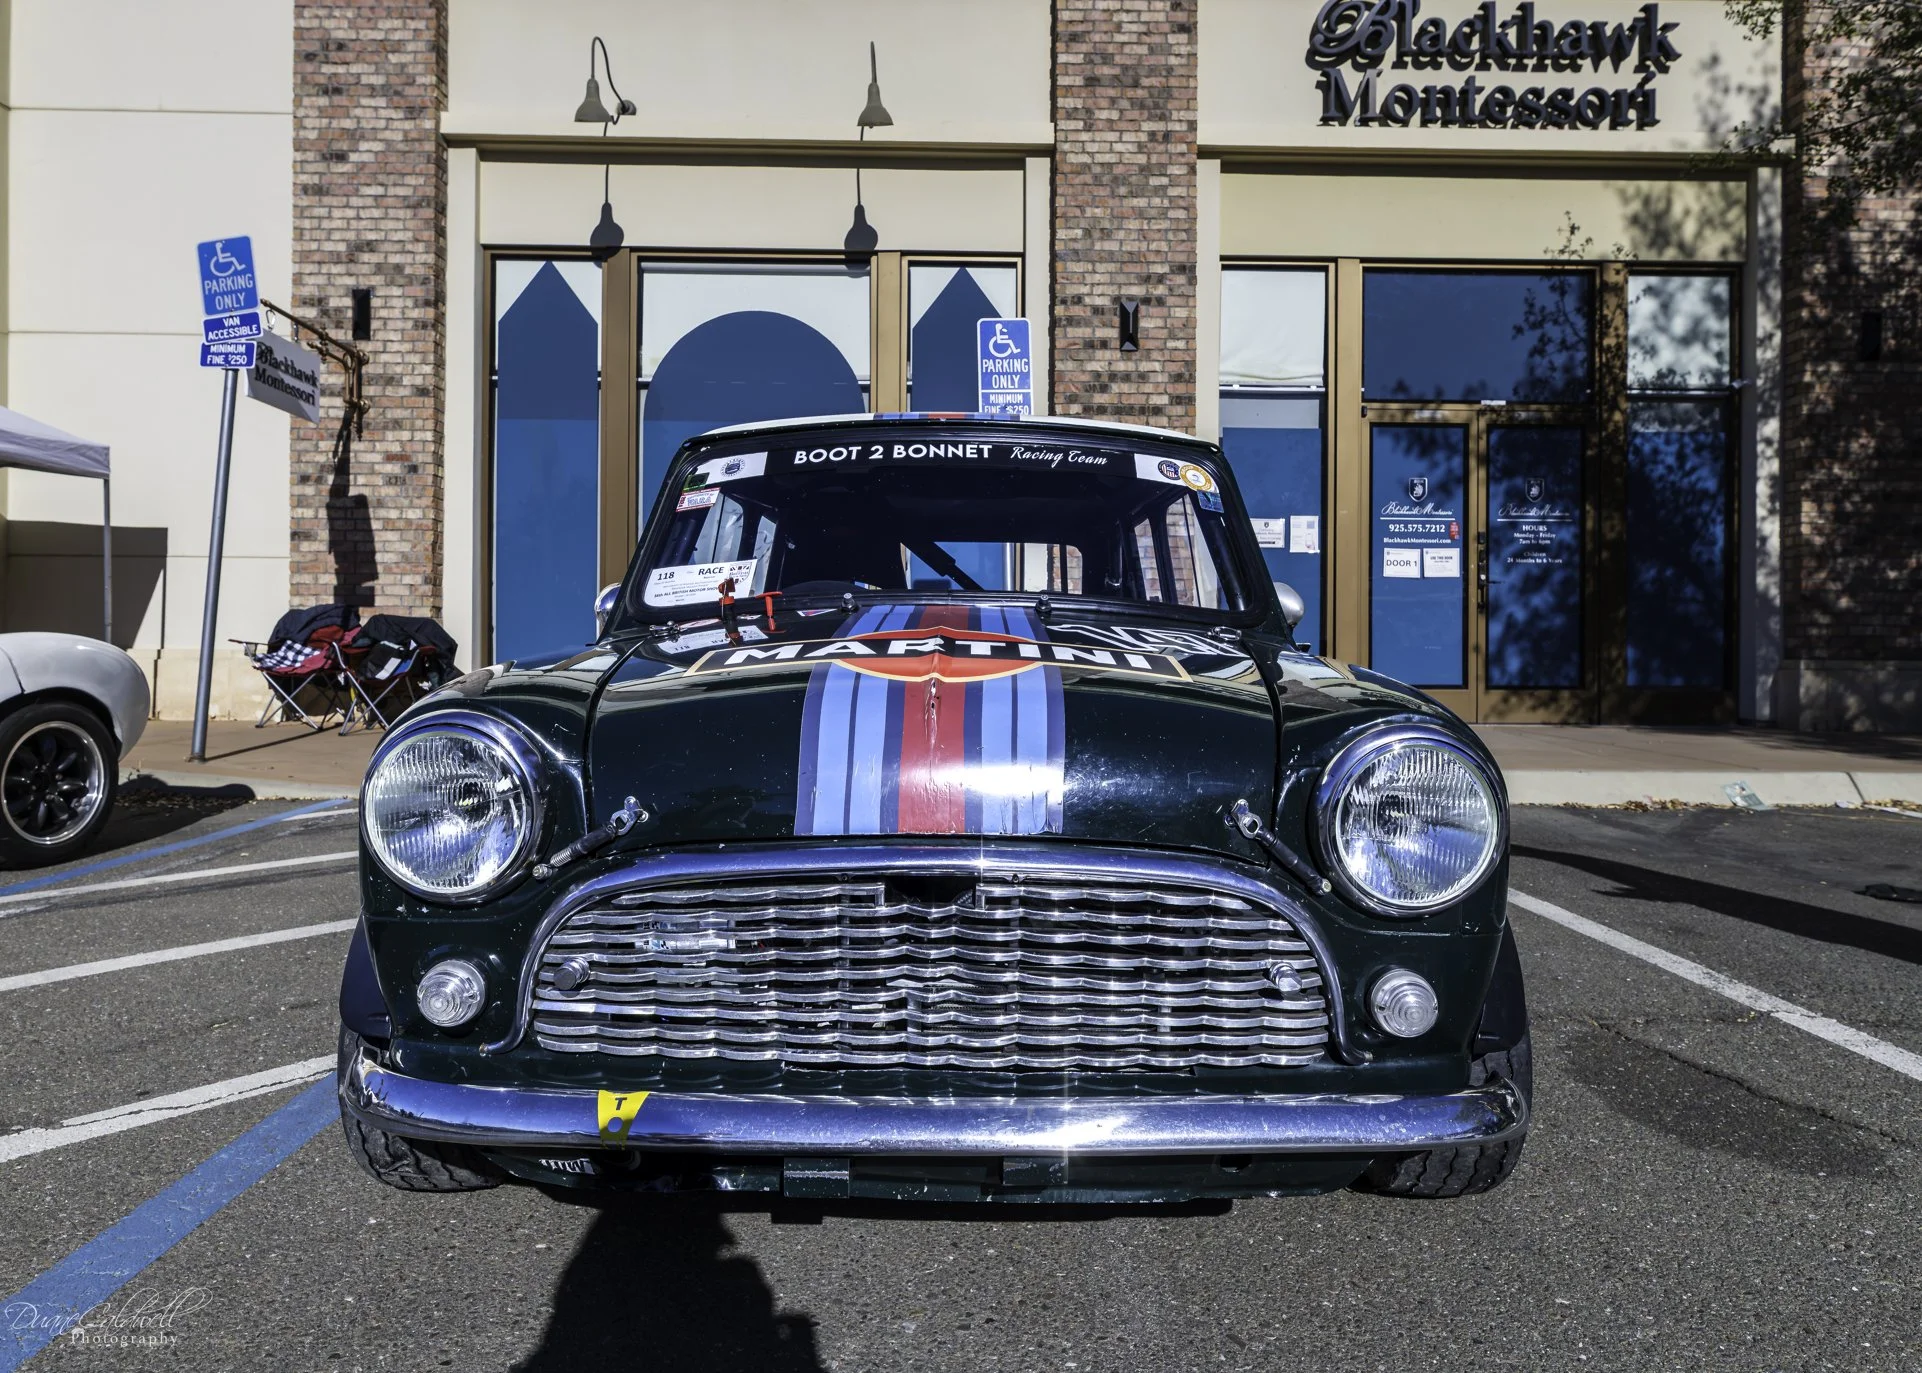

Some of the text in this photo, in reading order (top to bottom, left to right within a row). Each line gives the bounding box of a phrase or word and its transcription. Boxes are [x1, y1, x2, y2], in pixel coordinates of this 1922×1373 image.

[1309, 0, 1682, 64] Blackhawk
[1319, 68, 1661, 126] Montessori
[204, 273, 254, 295] PARKING
[215, 292, 246, 311] ONLY
[222, 316, 241, 327] VAN
[207, 325, 259, 341] ACCESSIBLE
[209, 344, 246, 354] MINIMUM
[206, 354, 248, 365] FINE $250
[256, 341, 319, 388] Blackhawk
[982, 358, 1029, 373] PARKING
[254, 364, 316, 406] Montessori
[991, 374, 1020, 389] ONLY
[989, 393, 1024, 404] MINIMUM
[984, 405, 1029, 415] FINE $250
[793, 443, 1108, 468] BOOT 2 BONNET Racing Team
[1388, 523, 1446, 533] 925.575.7212
[1386, 559, 1412, 567] DOOR
[657, 571, 675, 581] 118
[698, 566, 725, 576] RACE
[723, 636, 1153, 670] MARTINI
[614, 1097, 628, 1111] T
